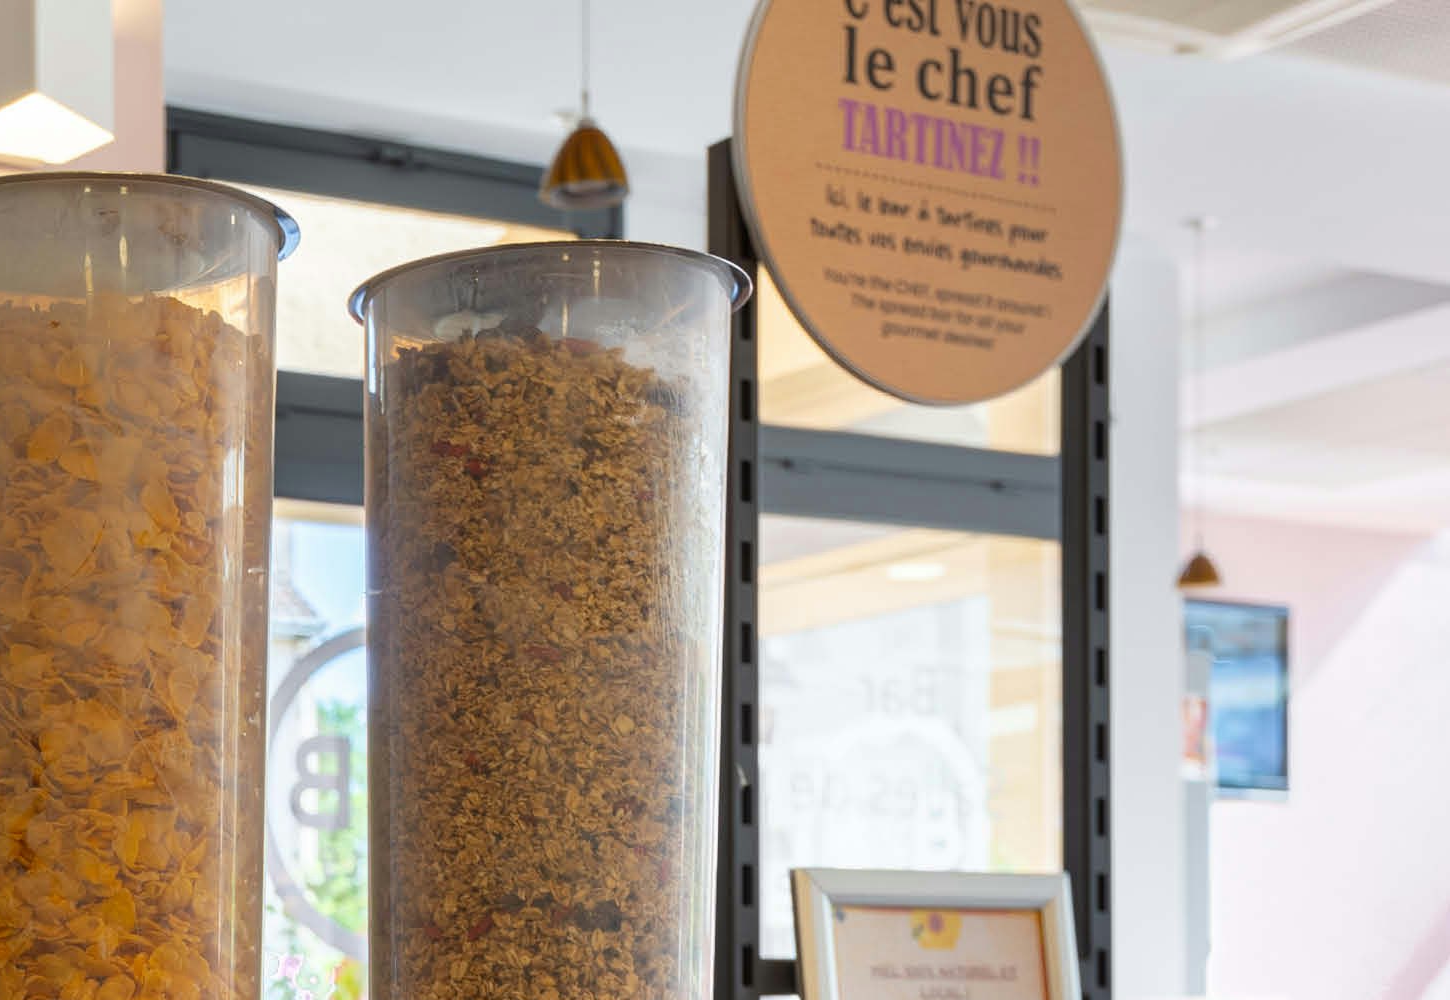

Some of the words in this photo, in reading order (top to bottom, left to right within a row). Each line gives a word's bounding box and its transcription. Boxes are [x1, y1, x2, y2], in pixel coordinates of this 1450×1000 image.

[844, 0, 940, 37] est
[955, 0, 1043, 59] vous
[842, 23, 895, 91] le
[916, 46, 1044, 121] chef
[838, 96, 1006, 181] TARTINEZ
[1017, 132, 1042, 187] !!
[878, 195, 909, 217] bar
[917, 196, 931, 220] à
[1007, 223, 1048, 248] pour
